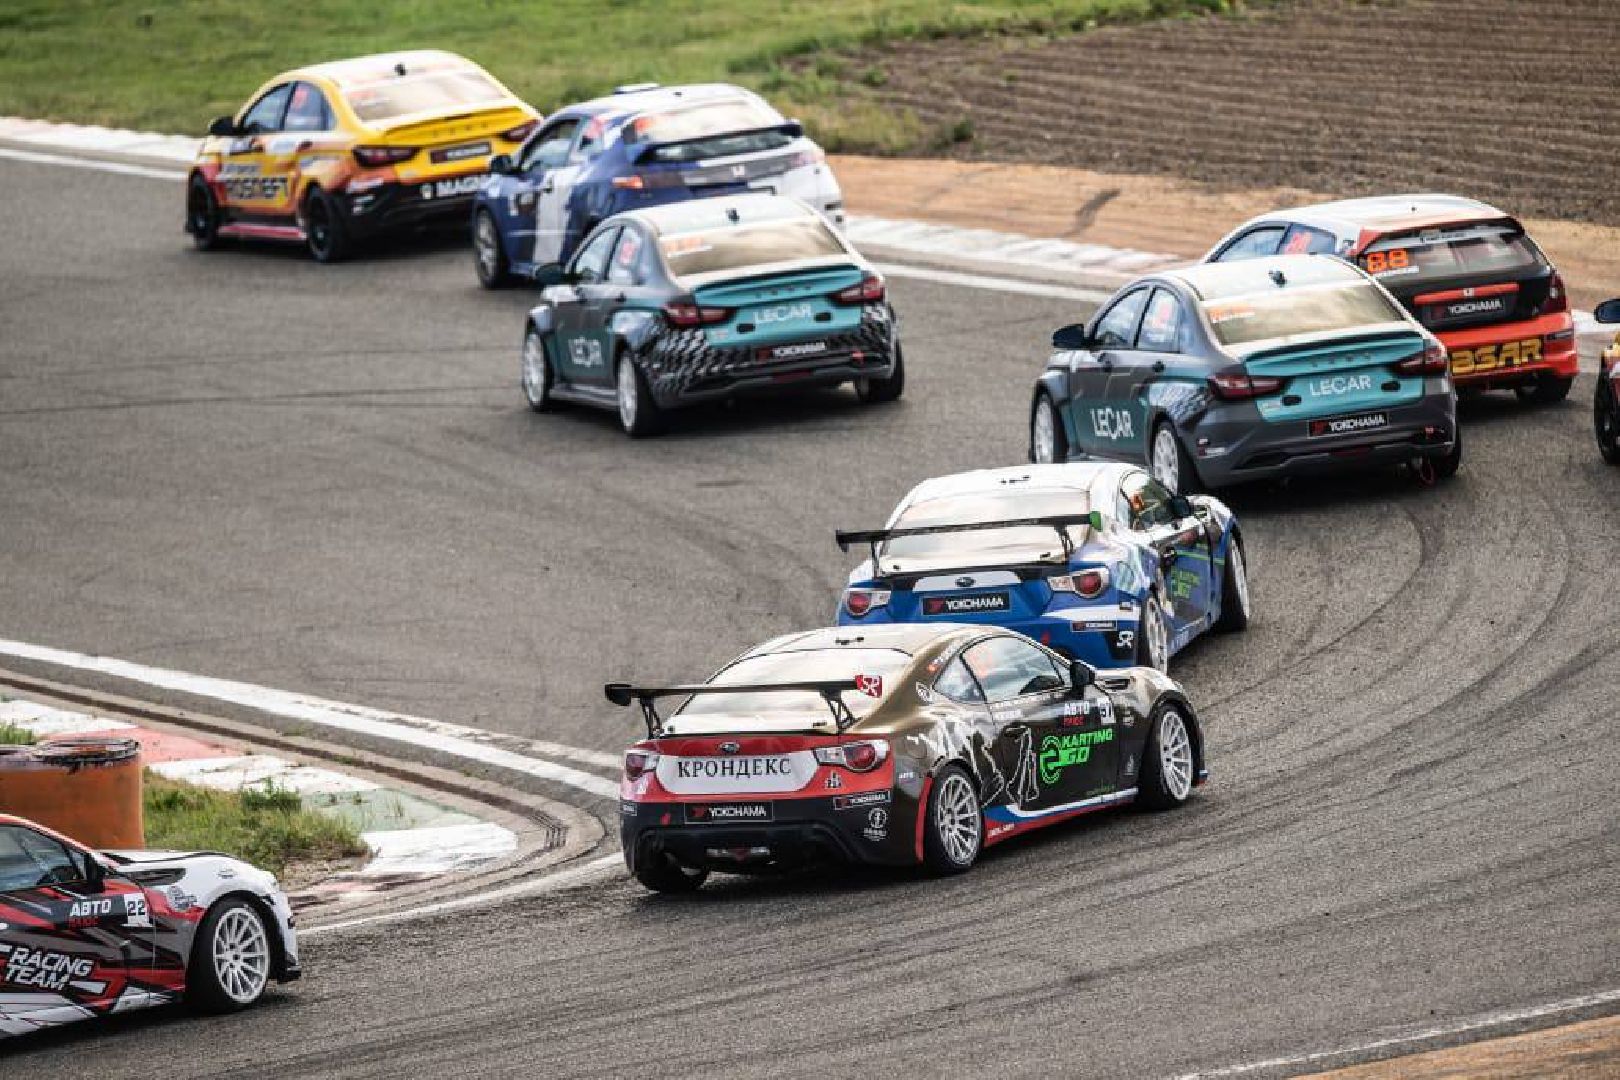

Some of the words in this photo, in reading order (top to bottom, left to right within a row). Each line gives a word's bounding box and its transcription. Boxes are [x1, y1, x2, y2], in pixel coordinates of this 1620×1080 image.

[1367, 248, 1409, 274] 88
[753, 303, 812, 325] LECAR
[1447, 299, 1501, 315] YOKOHAMA
[1309, 374, 1371, 396] LECAR
[1089, 406, 1134, 440] LECAR
[1328, 414, 1385, 432] YOKOHAMA
[945, 595, 1004, 611] YOKOHAMA
[1061, 728, 1113, 748] KARTING
[677, 758, 792, 779] КРОНДЕКС
[708, 805, 767, 818] YOKOHAMA
[127, 899, 147, 916] 22
[8, 946, 95, 977] RACING
[5, 963, 70, 991] TEAM
